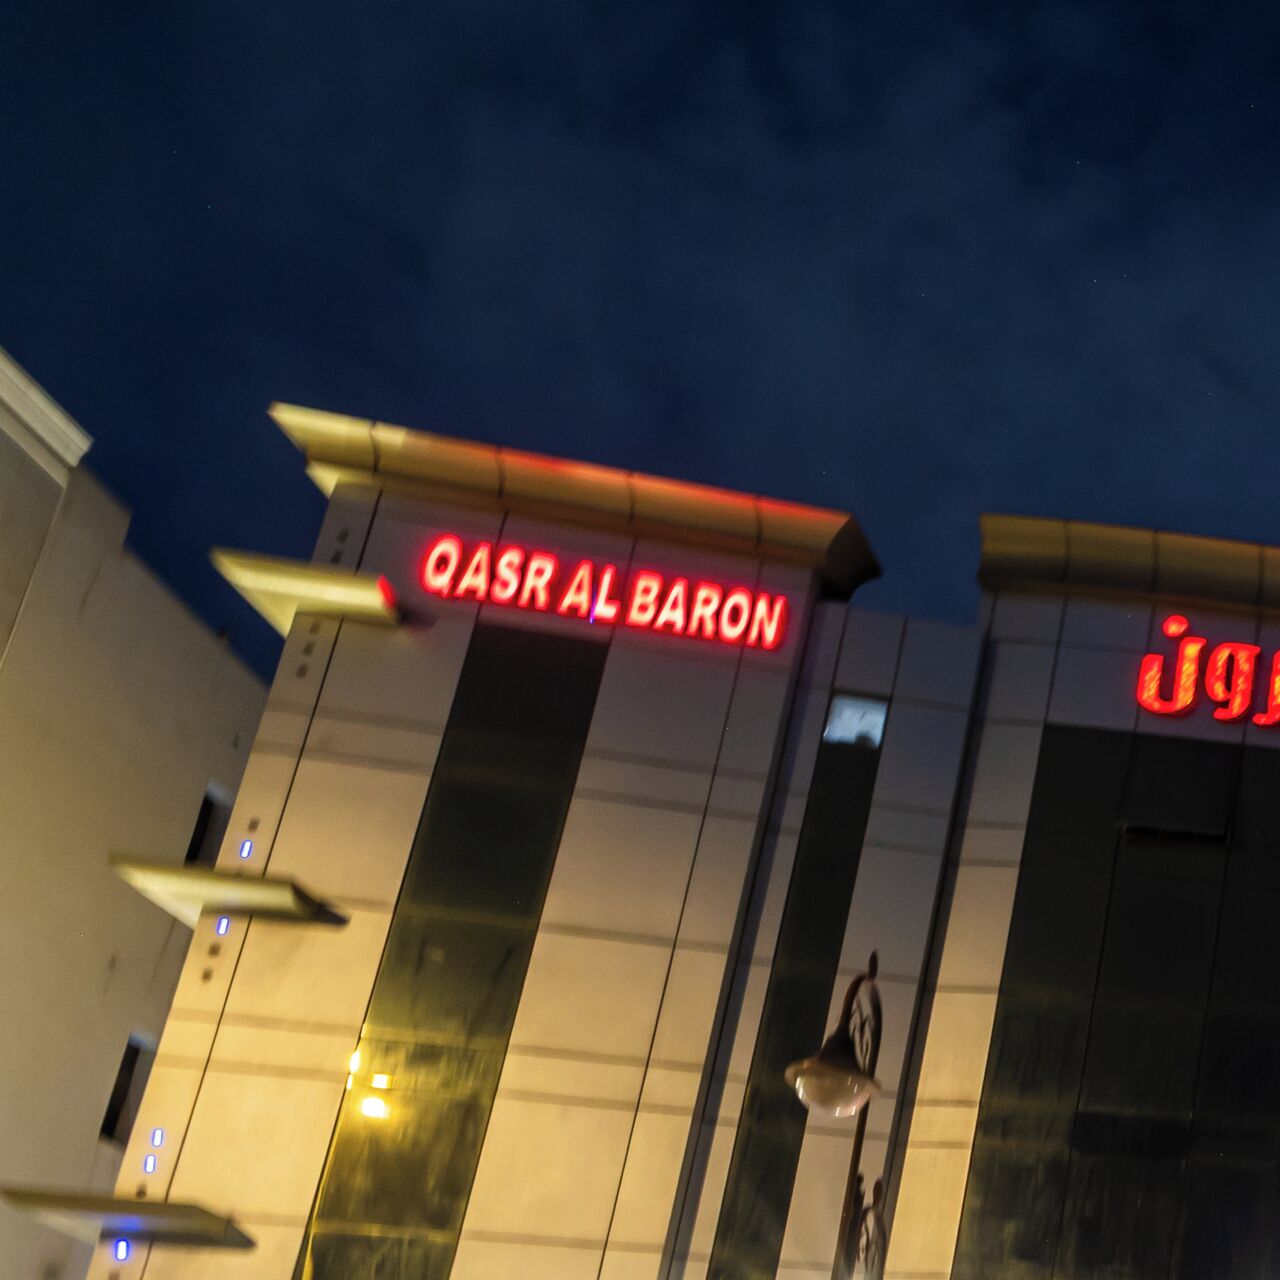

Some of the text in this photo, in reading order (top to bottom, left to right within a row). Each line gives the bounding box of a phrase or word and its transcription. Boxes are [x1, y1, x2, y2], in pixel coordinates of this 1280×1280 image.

[421, 533, 787, 651] QASR AL BARON
